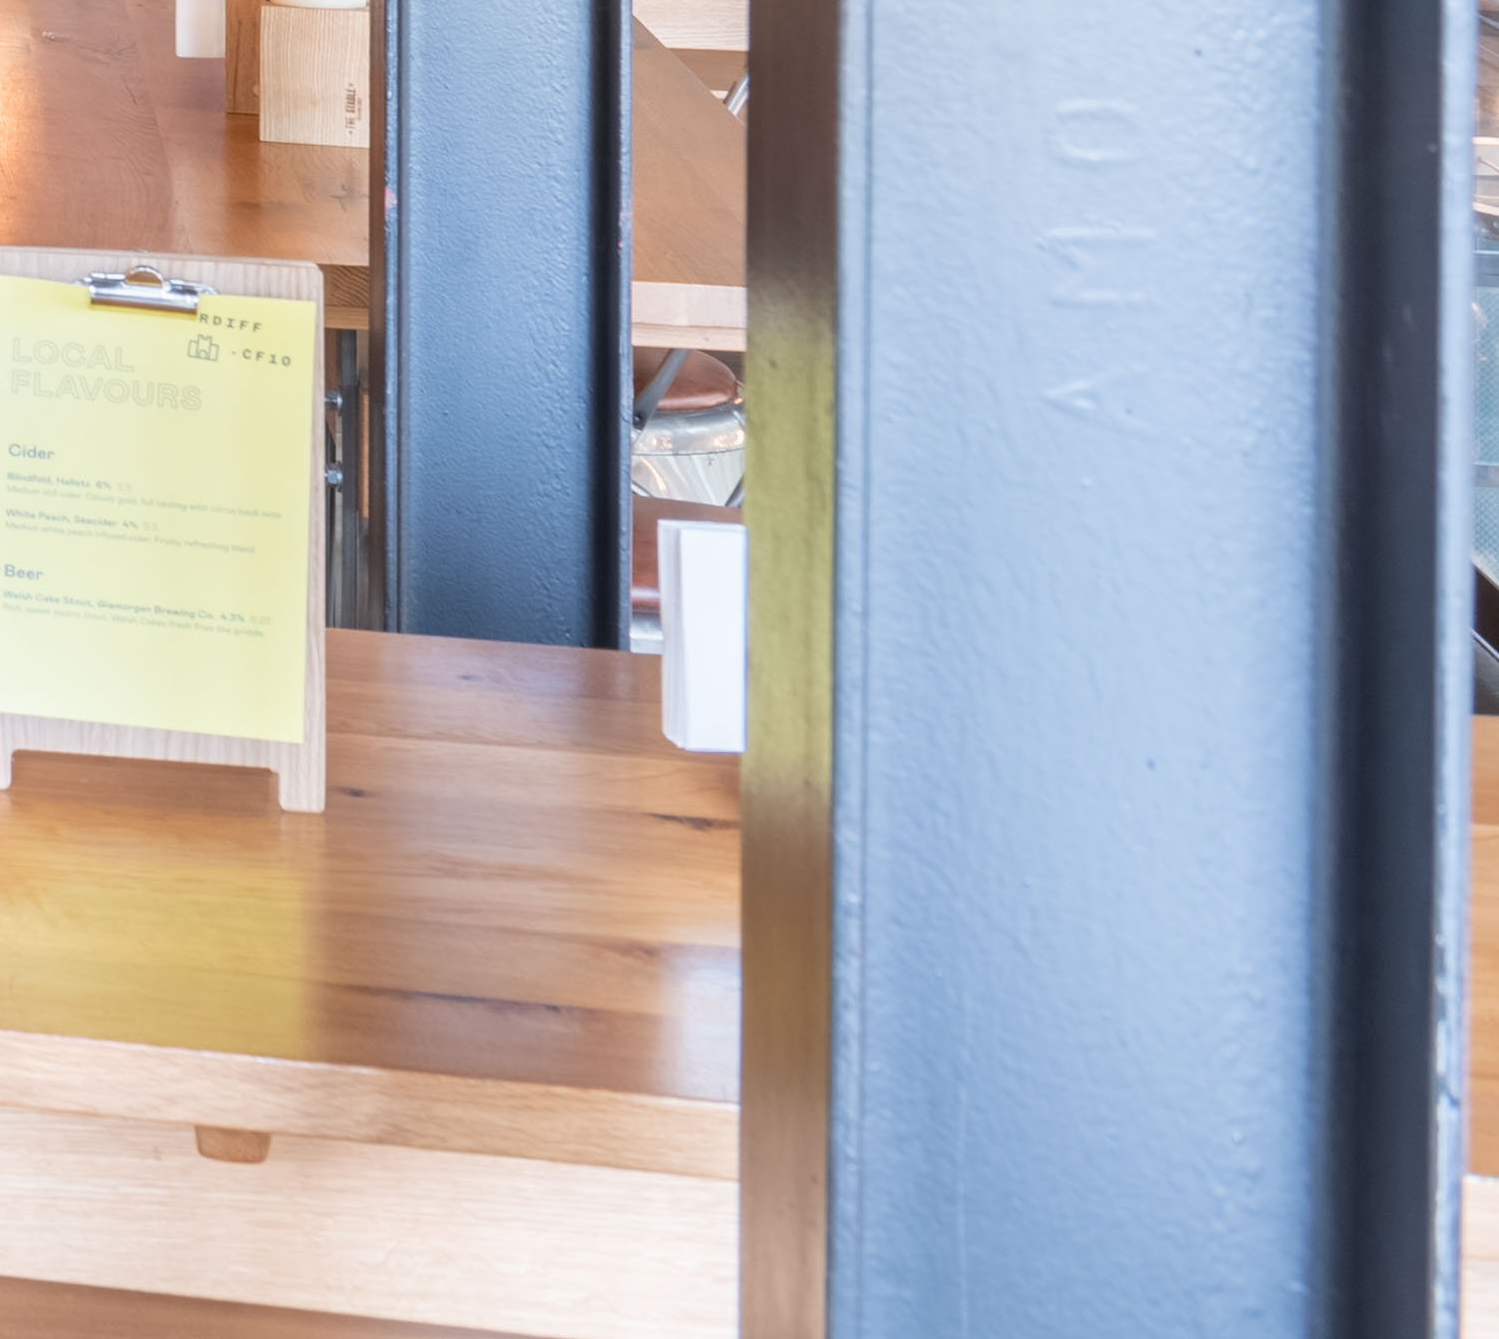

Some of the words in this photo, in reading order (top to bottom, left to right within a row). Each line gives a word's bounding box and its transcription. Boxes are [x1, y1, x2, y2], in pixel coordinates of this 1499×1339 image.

[198, 313, 263, 333] RDIFF
[11, 337, 135, 373] LOCAL
[10, 369, 203, 411] FLAVOURS
[8, 443, 56, 460] Cider
[5, 507, 36, 518] White
[4, 563, 44, 580] Beer
[2, 589, 32, 601] Welsh
[34, 593, 60, 603] Cake
